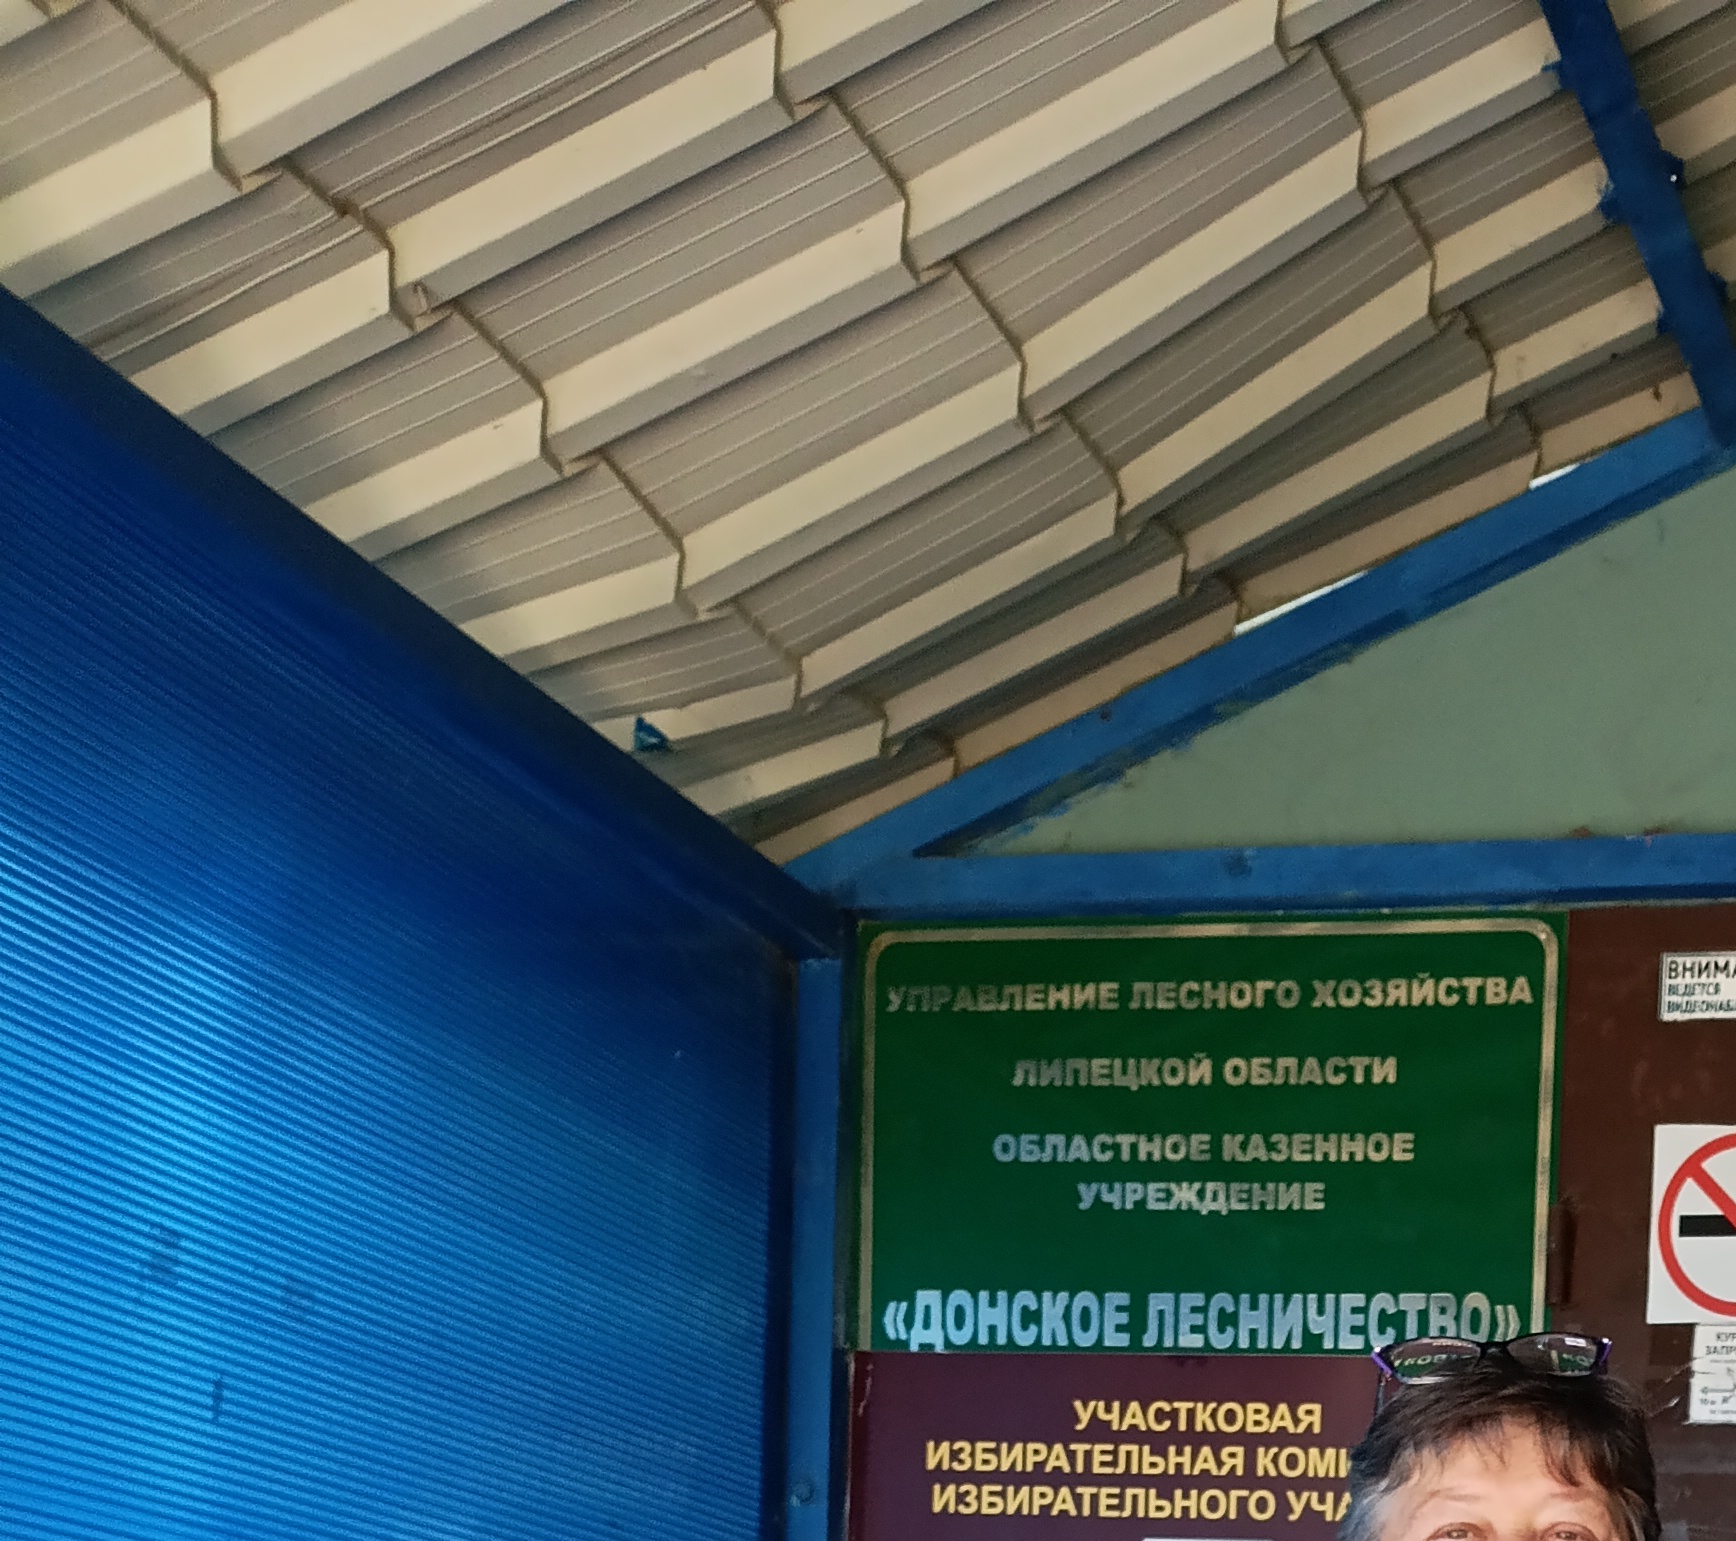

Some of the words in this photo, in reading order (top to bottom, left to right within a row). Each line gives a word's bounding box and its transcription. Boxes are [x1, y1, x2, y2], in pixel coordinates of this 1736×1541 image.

[886, 983, 1120, 1012] УПРАВЛЕНИЕ
[1128, 979, 1301, 1010] ЛЕСНОГО
[1311, 972, 1534, 1008] ХОЗЯЙСТВА
[1011, 1052, 1213, 1091] ЛИПЕЦКОЙ
[1223, 1056, 1397, 1086] ОБЛАСТИ
[992, 1133, 1211, 1163] ОБЛАСТНОЕ
[1222, 1133, 1415, 1162] КАЗЕННОЕ
[1076, 1182, 1326, 1215] УЧРЕЖДЕНИЕ
[883, 1289, 1131, 1353] «ДОНСКОЕ
[1142, 1292, 1522, 1350] ЛЕСНИЧЕСТВО»
[1073, 1400, 1322, 1434] УЧАСТКОВАЯ
[925, 1440, 1245, 1477] ИЗБИРАТЕЛЬНАЯ
[931, 1483, 1276, 1521] ИЗБИРАТЕЛЬНОГО
